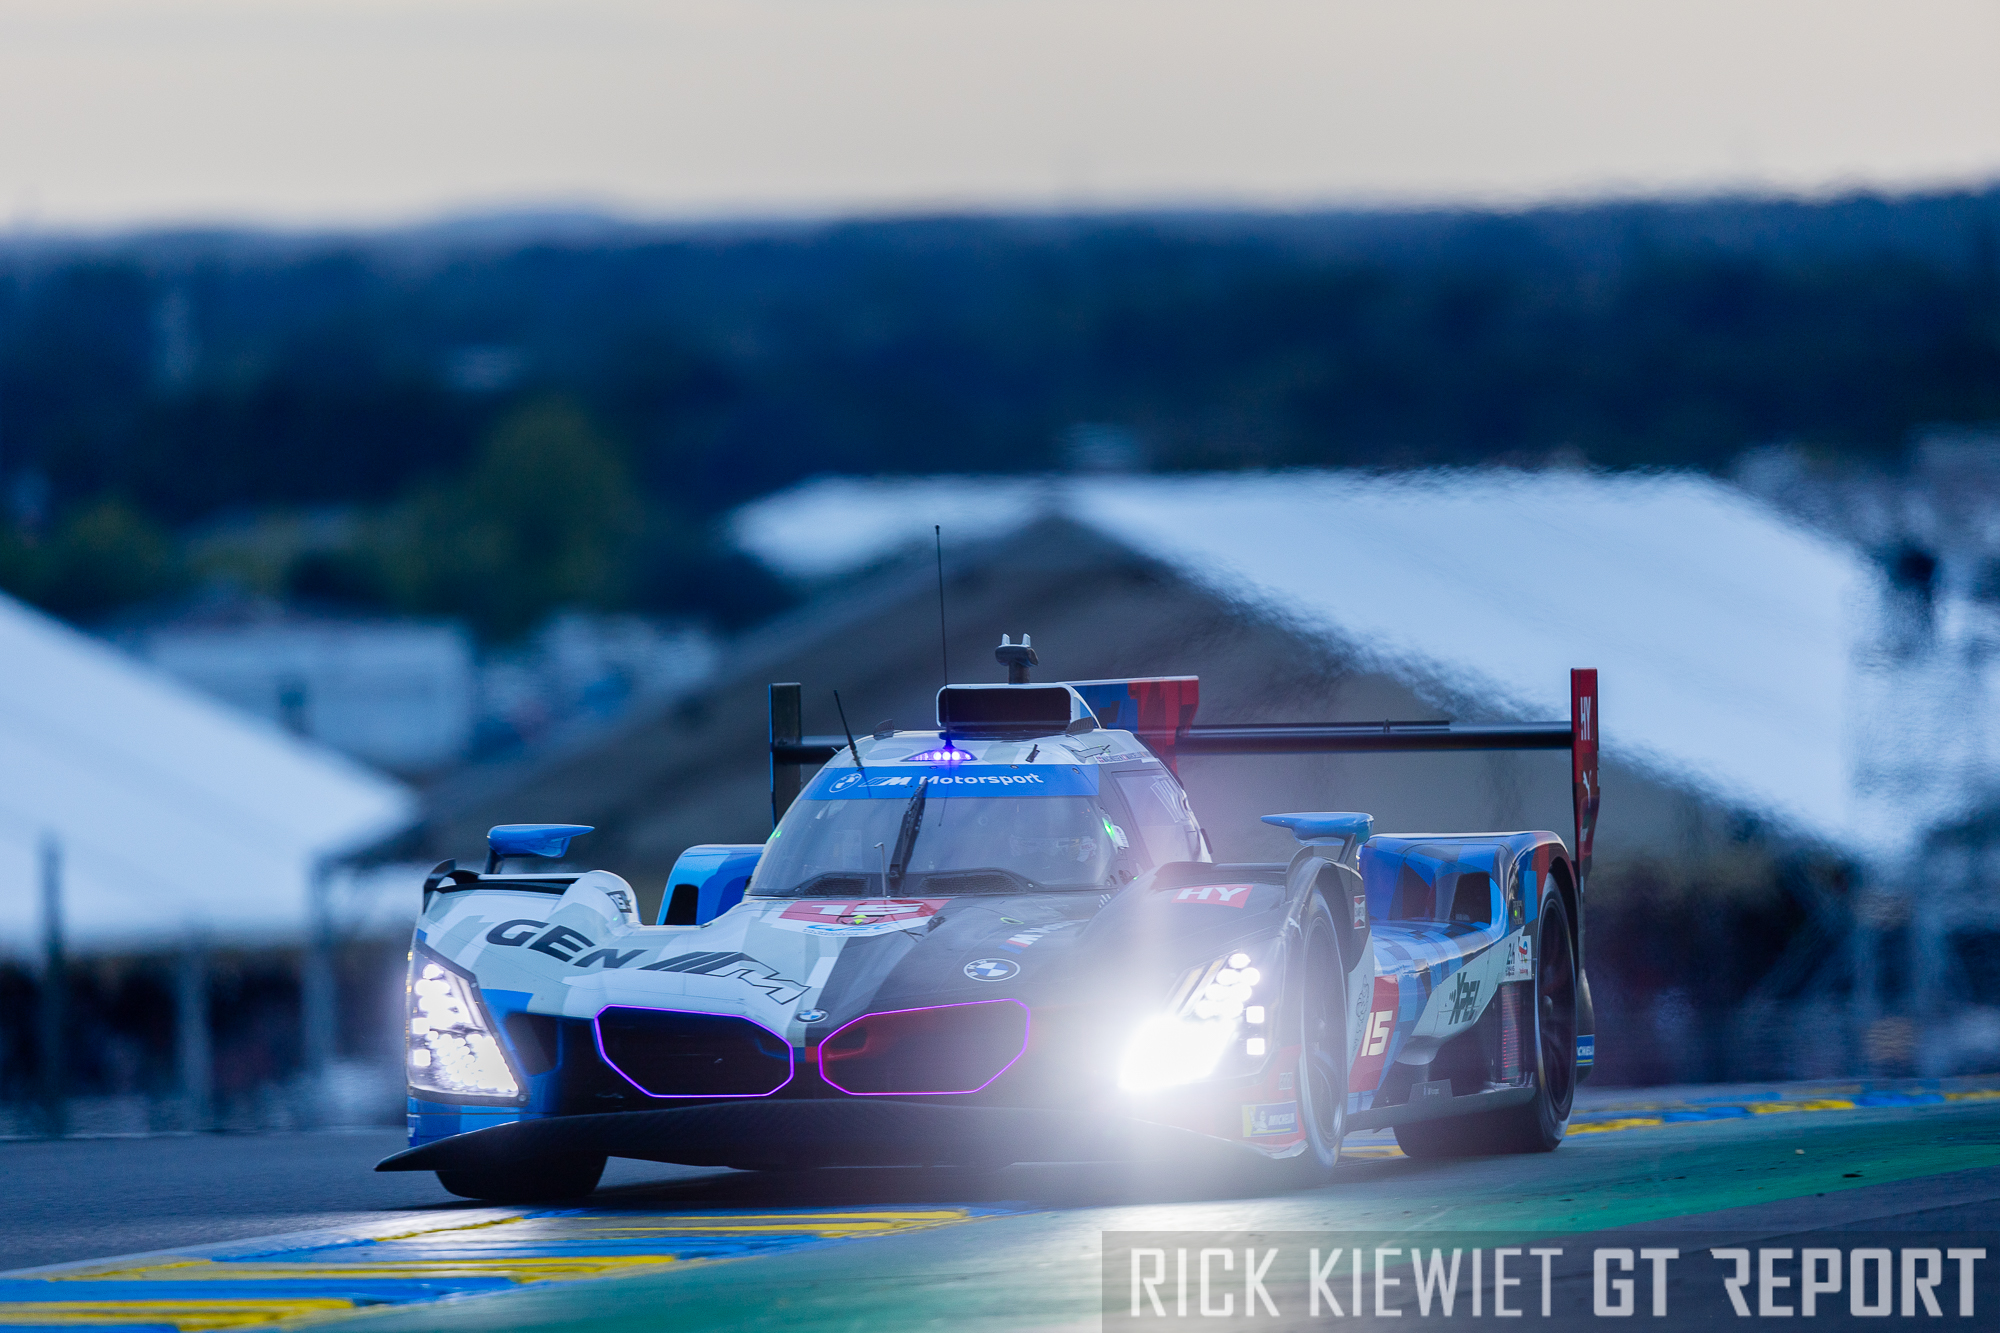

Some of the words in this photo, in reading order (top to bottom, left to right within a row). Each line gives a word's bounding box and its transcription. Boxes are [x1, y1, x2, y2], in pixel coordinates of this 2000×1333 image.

[1580, 696, 1591, 741] HY
[919, 773, 1044, 786] Motorsport
[811, 902, 924, 916] 15
[1176, 886, 1248, 901] HY
[486, 919, 648, 969] GEN
[1448, 971, 1480, 1025] XPEL
[1361, 1010, 1393, 1057] 15
